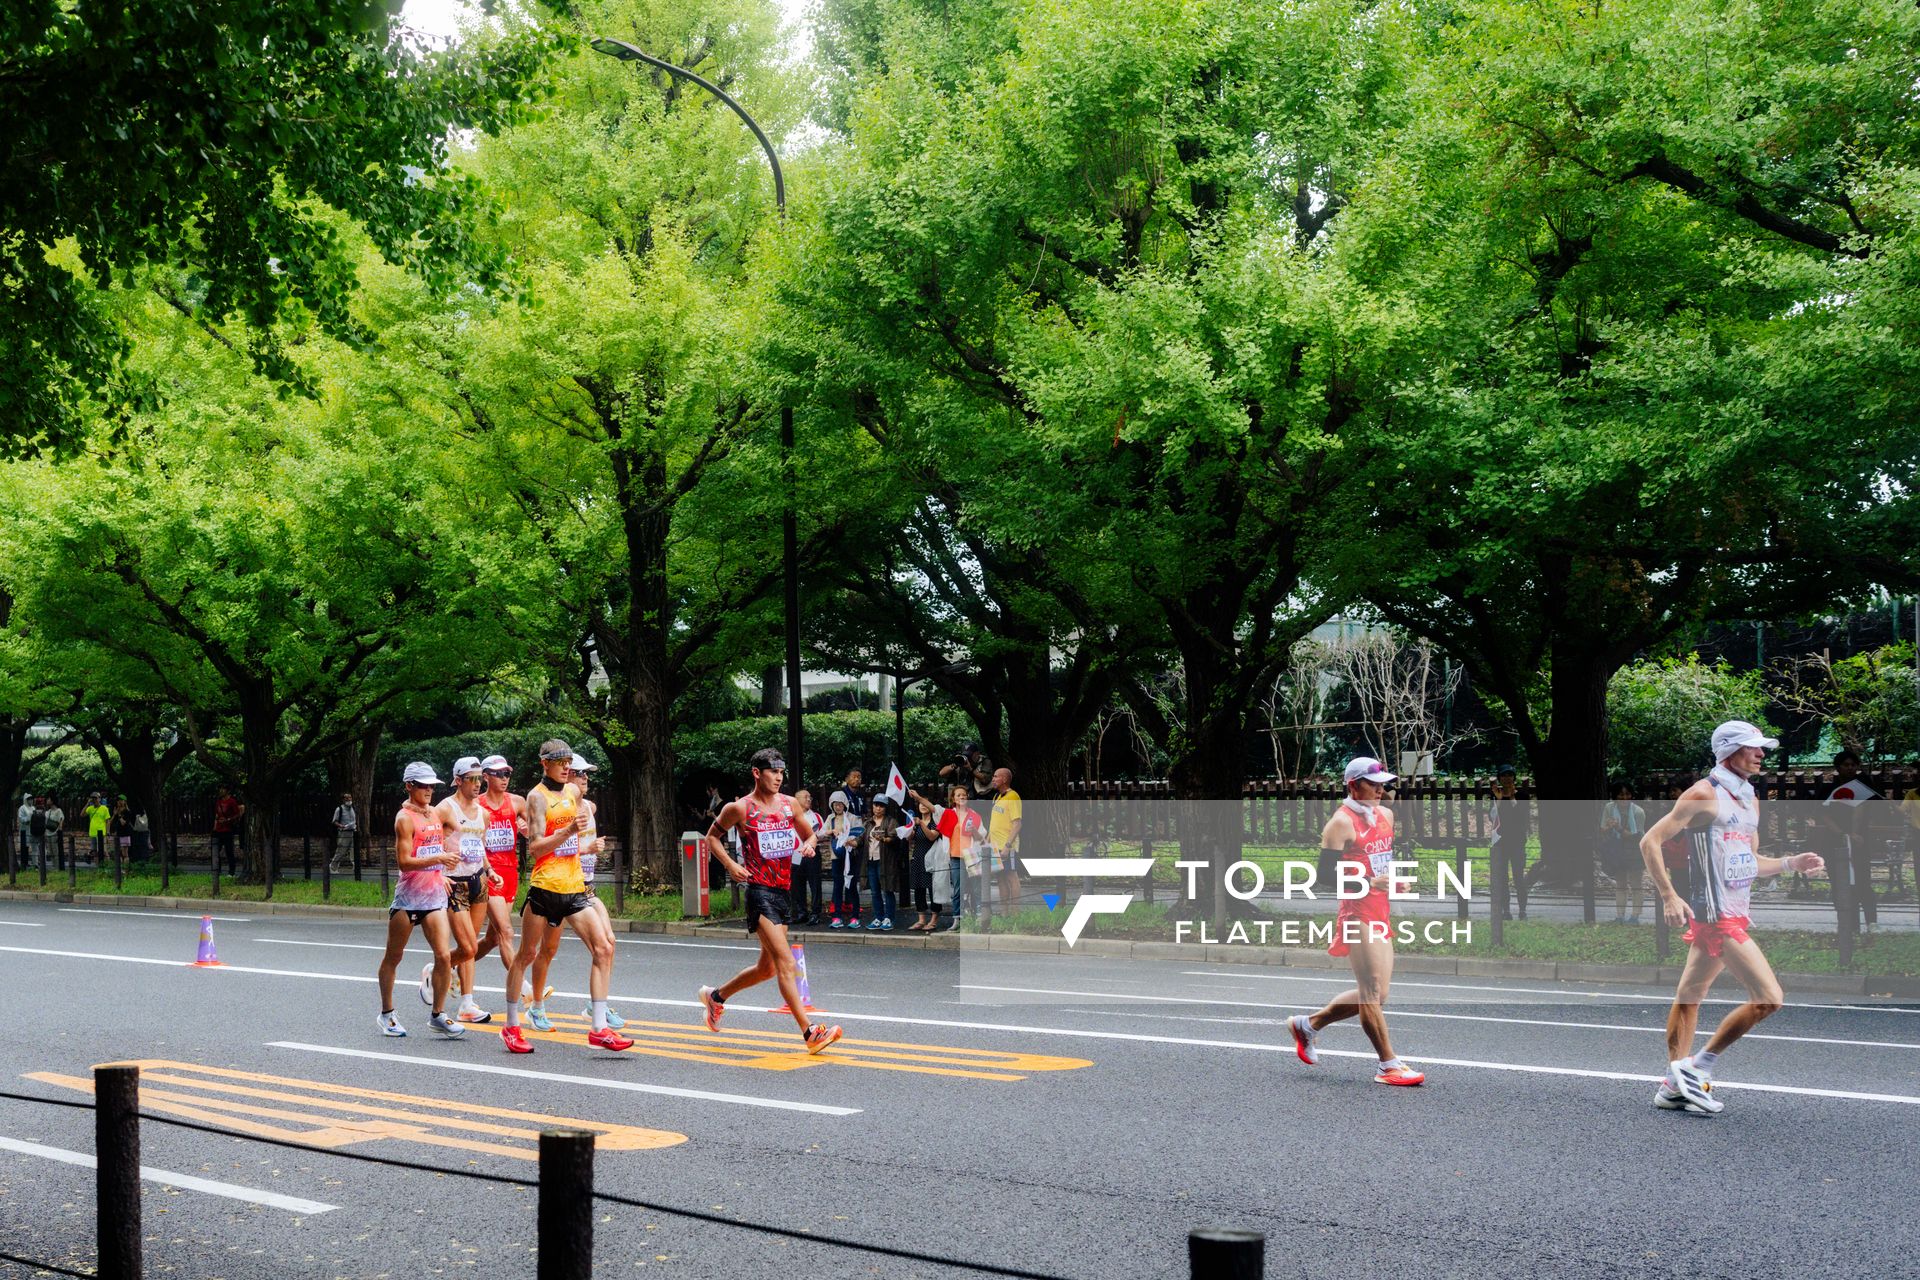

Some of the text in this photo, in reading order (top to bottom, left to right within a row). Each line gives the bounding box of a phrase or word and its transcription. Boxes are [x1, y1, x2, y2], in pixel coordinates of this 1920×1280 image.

[488, 819, 512, 830] HINA
[769, 831, 792, 839] TDK
[485, 838, 508, 846] WANG
[761, 840, 794, 851] SALAZAR
[427, 845, 442, 854] TDK
